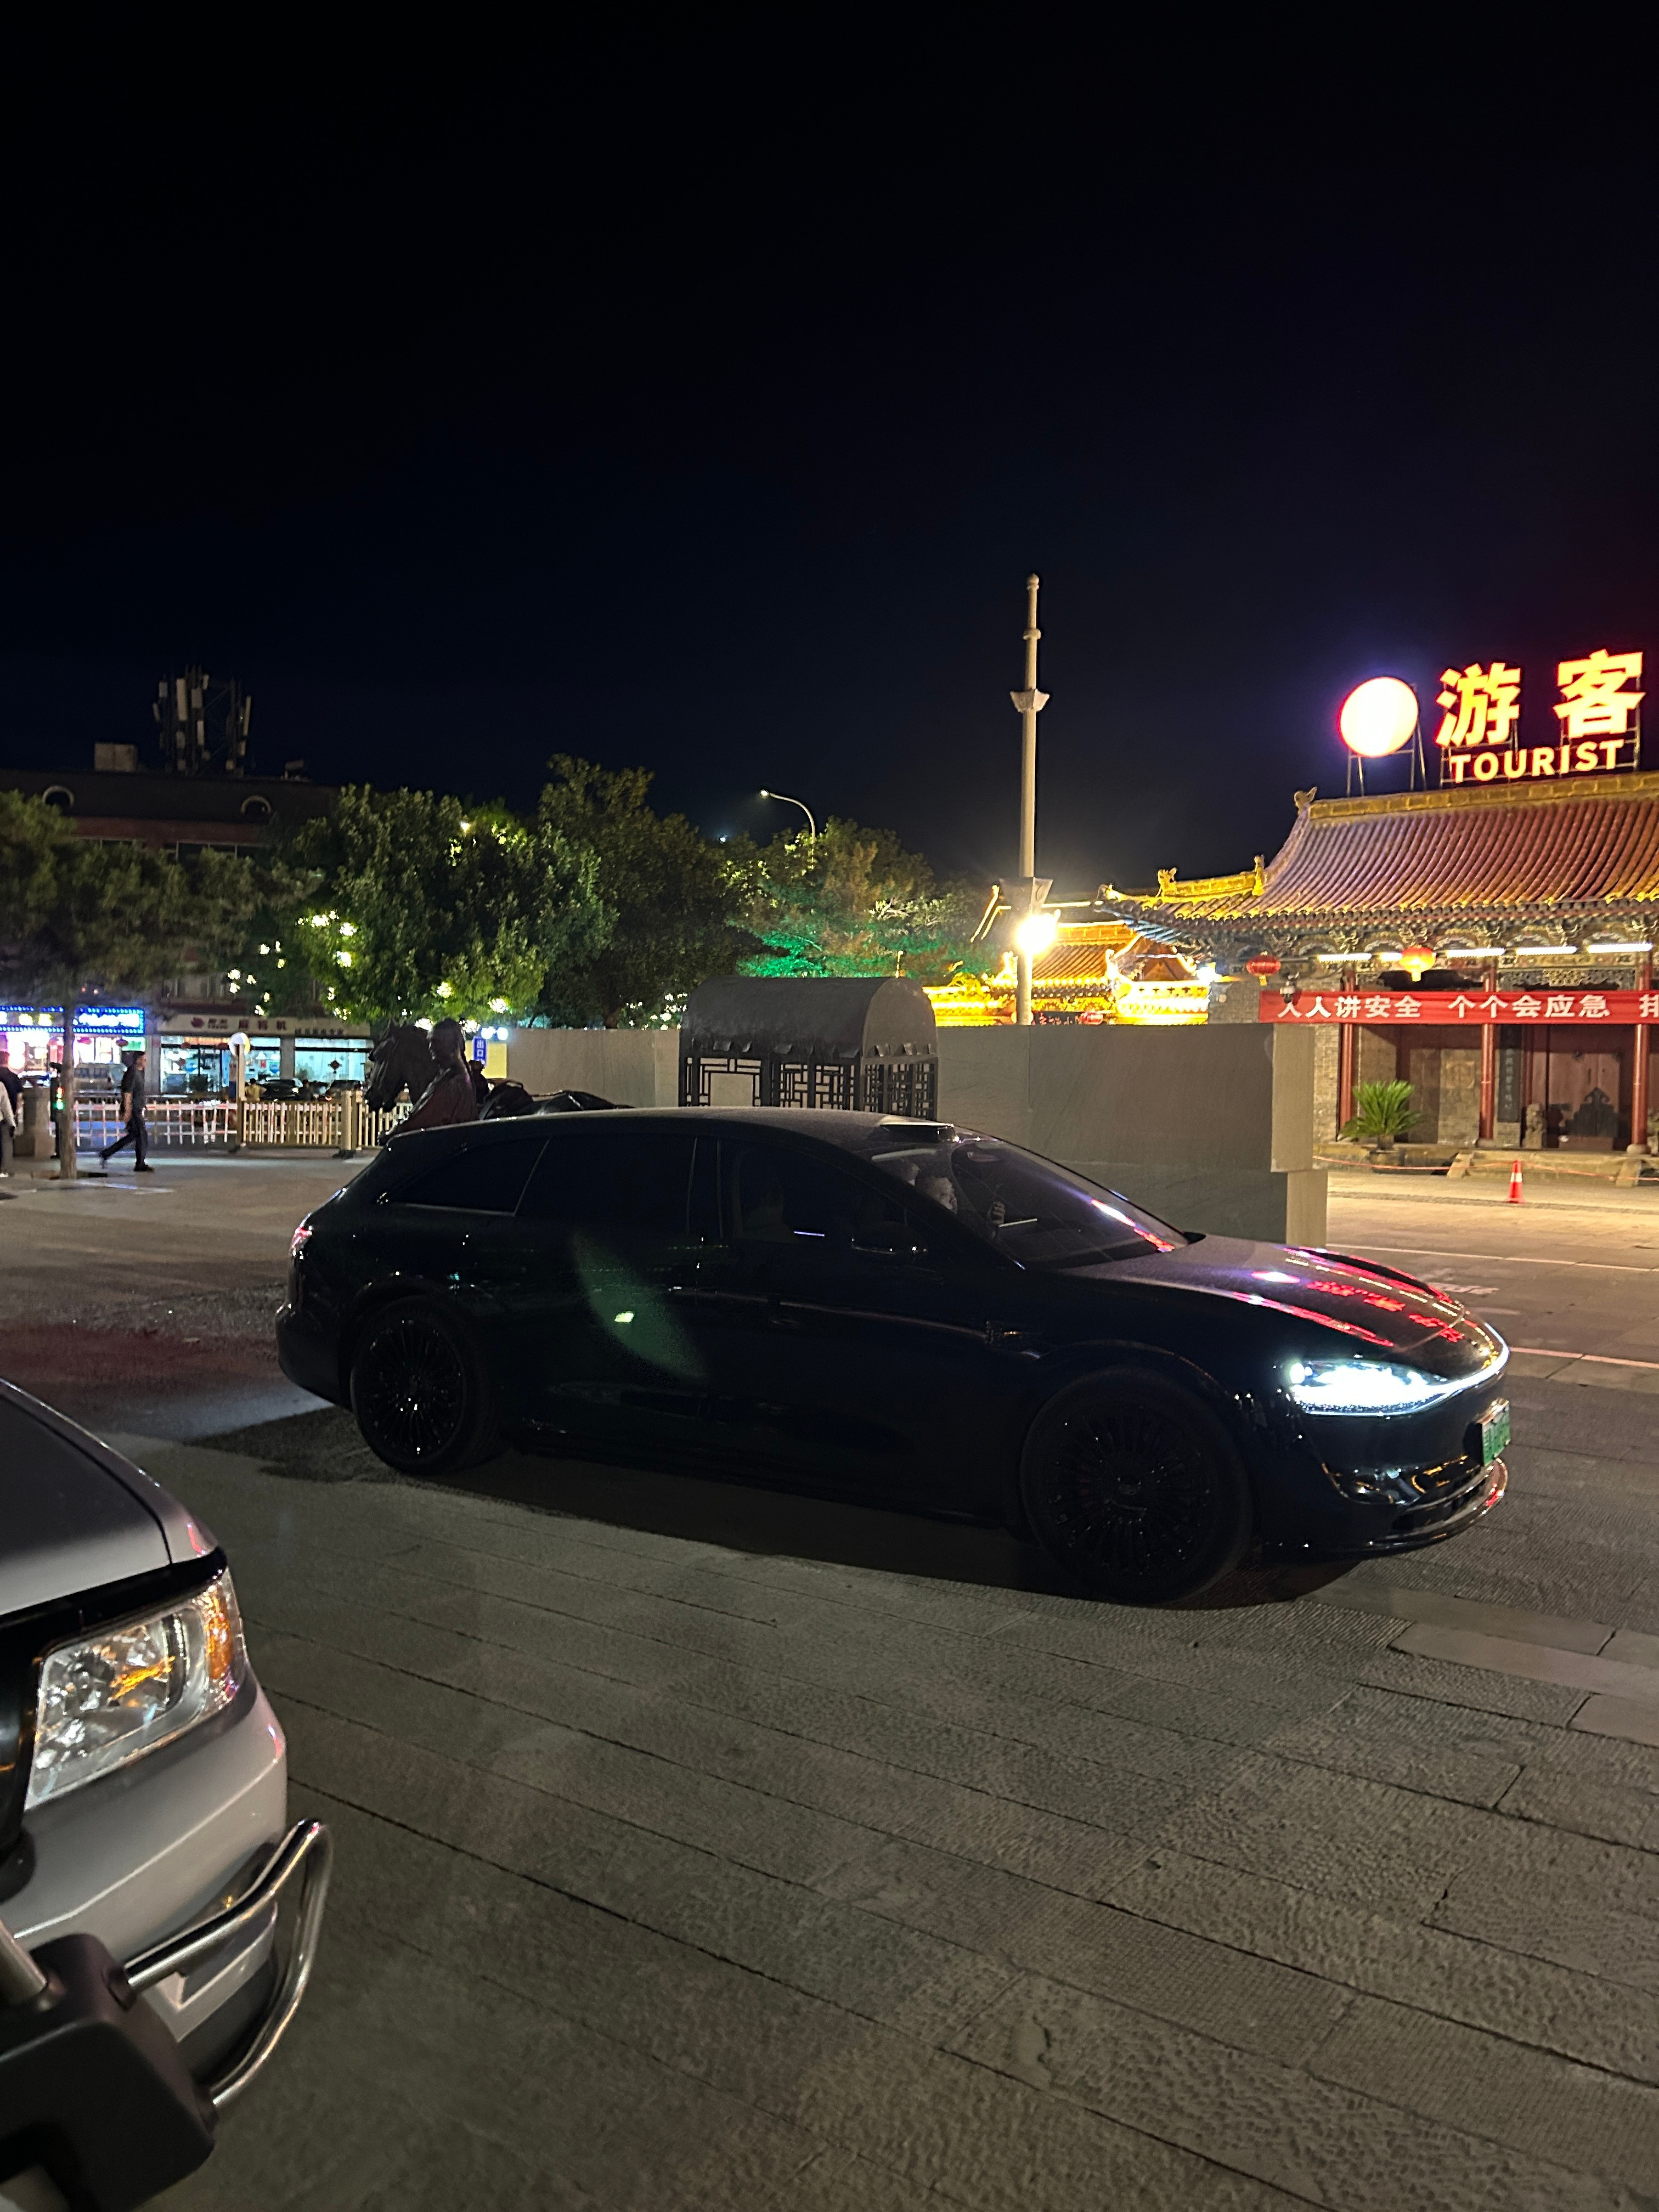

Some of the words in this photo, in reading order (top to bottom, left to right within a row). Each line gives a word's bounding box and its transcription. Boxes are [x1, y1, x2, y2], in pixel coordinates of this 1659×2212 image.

[1435, 649, 1646, 747] 游客
[1450, 740, 1624, 783] TOURIST
[1278, 995, 1422, 1018] 人人讲安全
[1448, 994, 1610, 1018] 个个会应急
